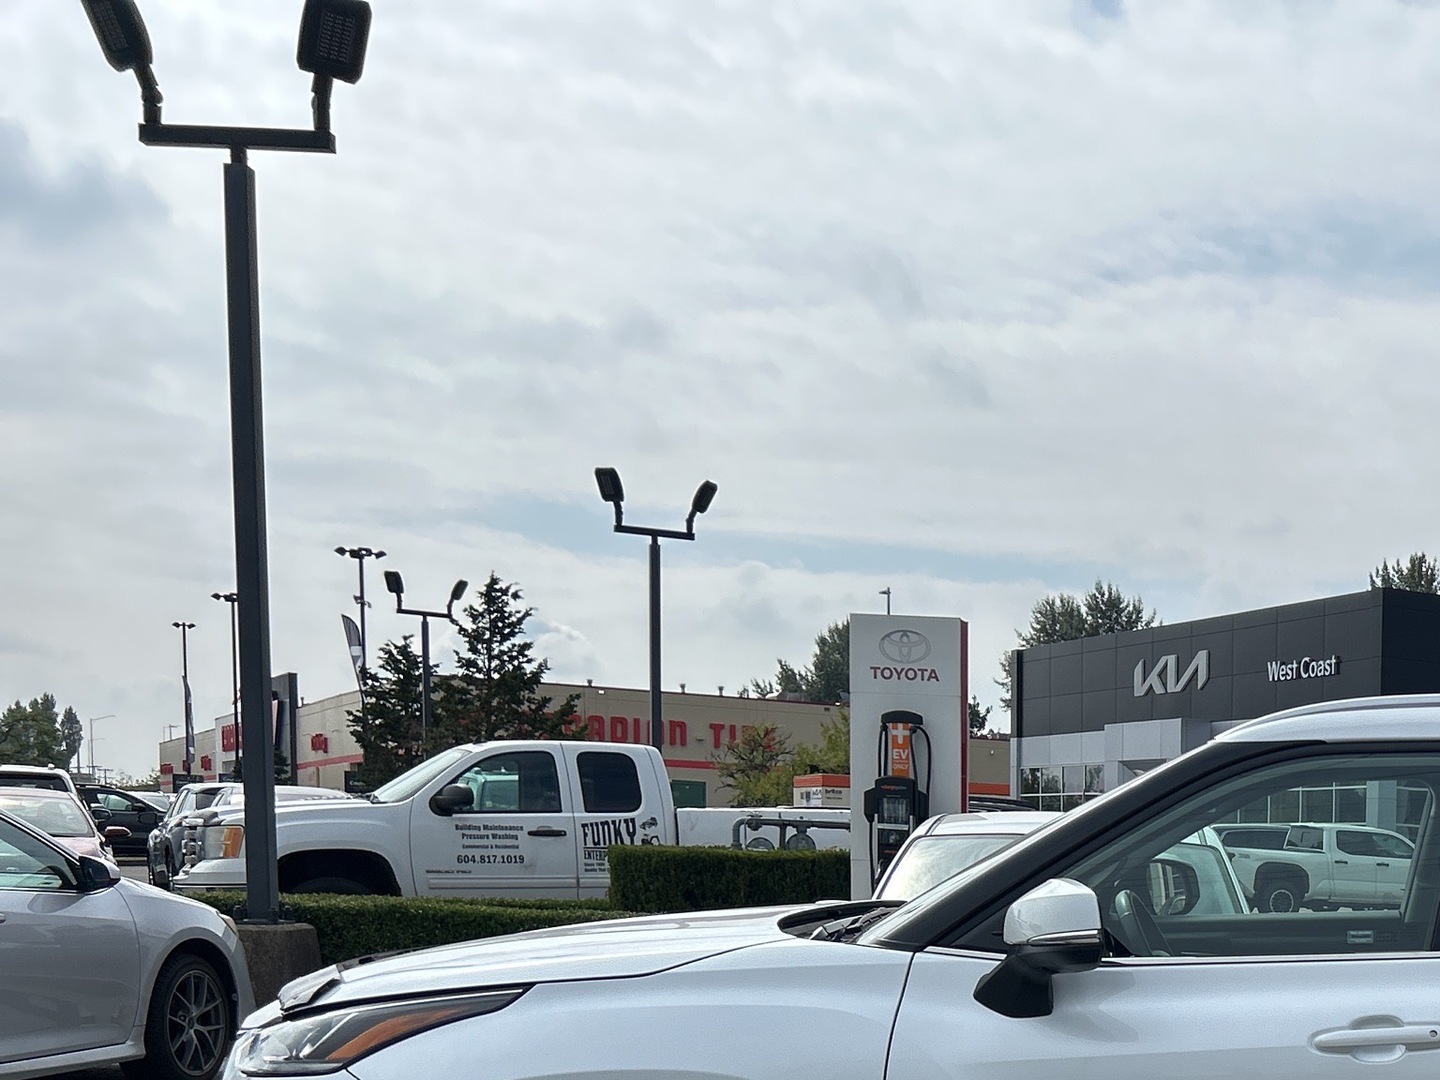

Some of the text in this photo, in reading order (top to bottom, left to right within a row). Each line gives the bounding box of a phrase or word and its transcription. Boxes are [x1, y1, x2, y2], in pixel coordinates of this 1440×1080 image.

[869, 666, 940, 682] TOYOTA
[1133, 650, 1210, 697] KIA
[1267, 655, 1337, 682] West Coast
[893, 749, 908, 759] EV
[455, 824, 481, 832] Building
[581, 817, 637, 847] FUNKY
[491, 833, 519, 841] Washing
[457, 854, 525, 864] 604.817.1019
